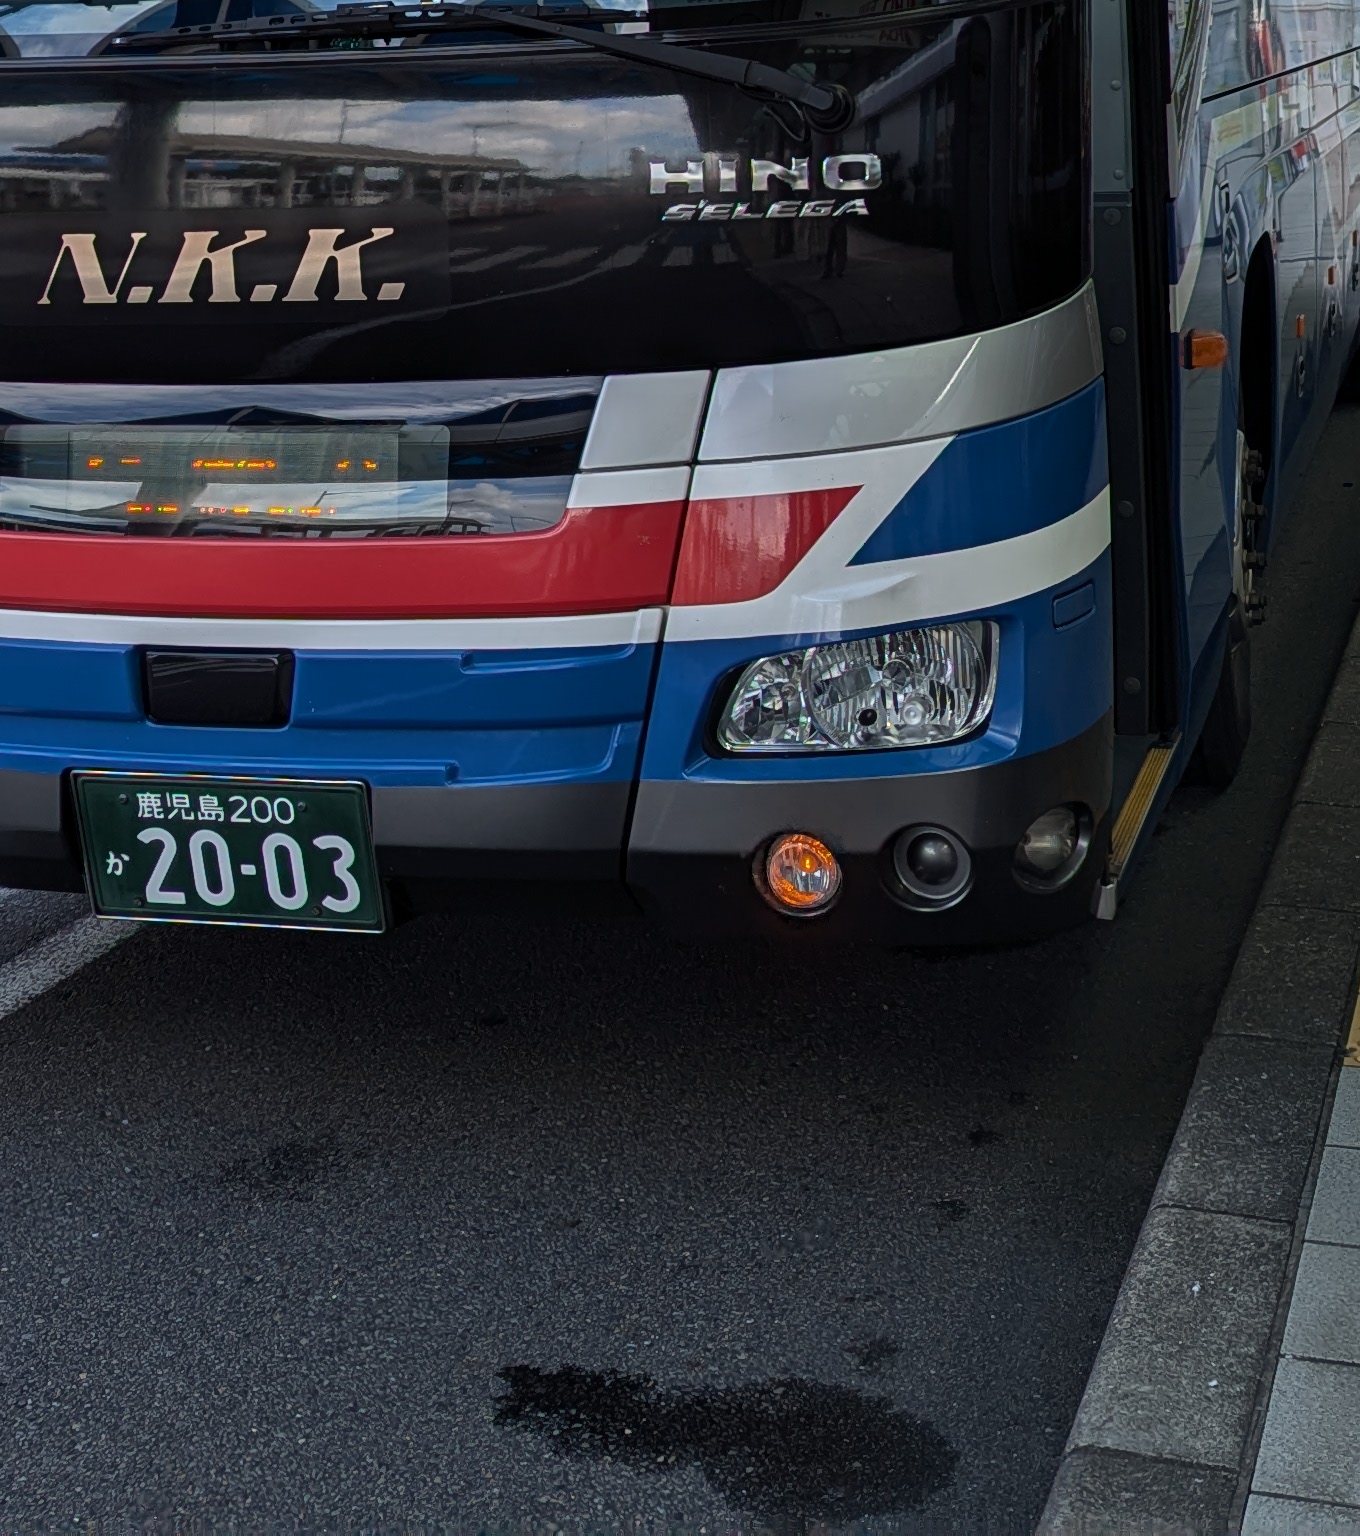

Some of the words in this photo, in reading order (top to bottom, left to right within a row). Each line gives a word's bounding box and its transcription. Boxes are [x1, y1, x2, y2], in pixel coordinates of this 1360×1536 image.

[649, 153, 883, 195] HINO
[37, 227, 405, 305] N.K.K.
[105, 850, 130, 876] か
[137, 827, 361, 913] 20-03
